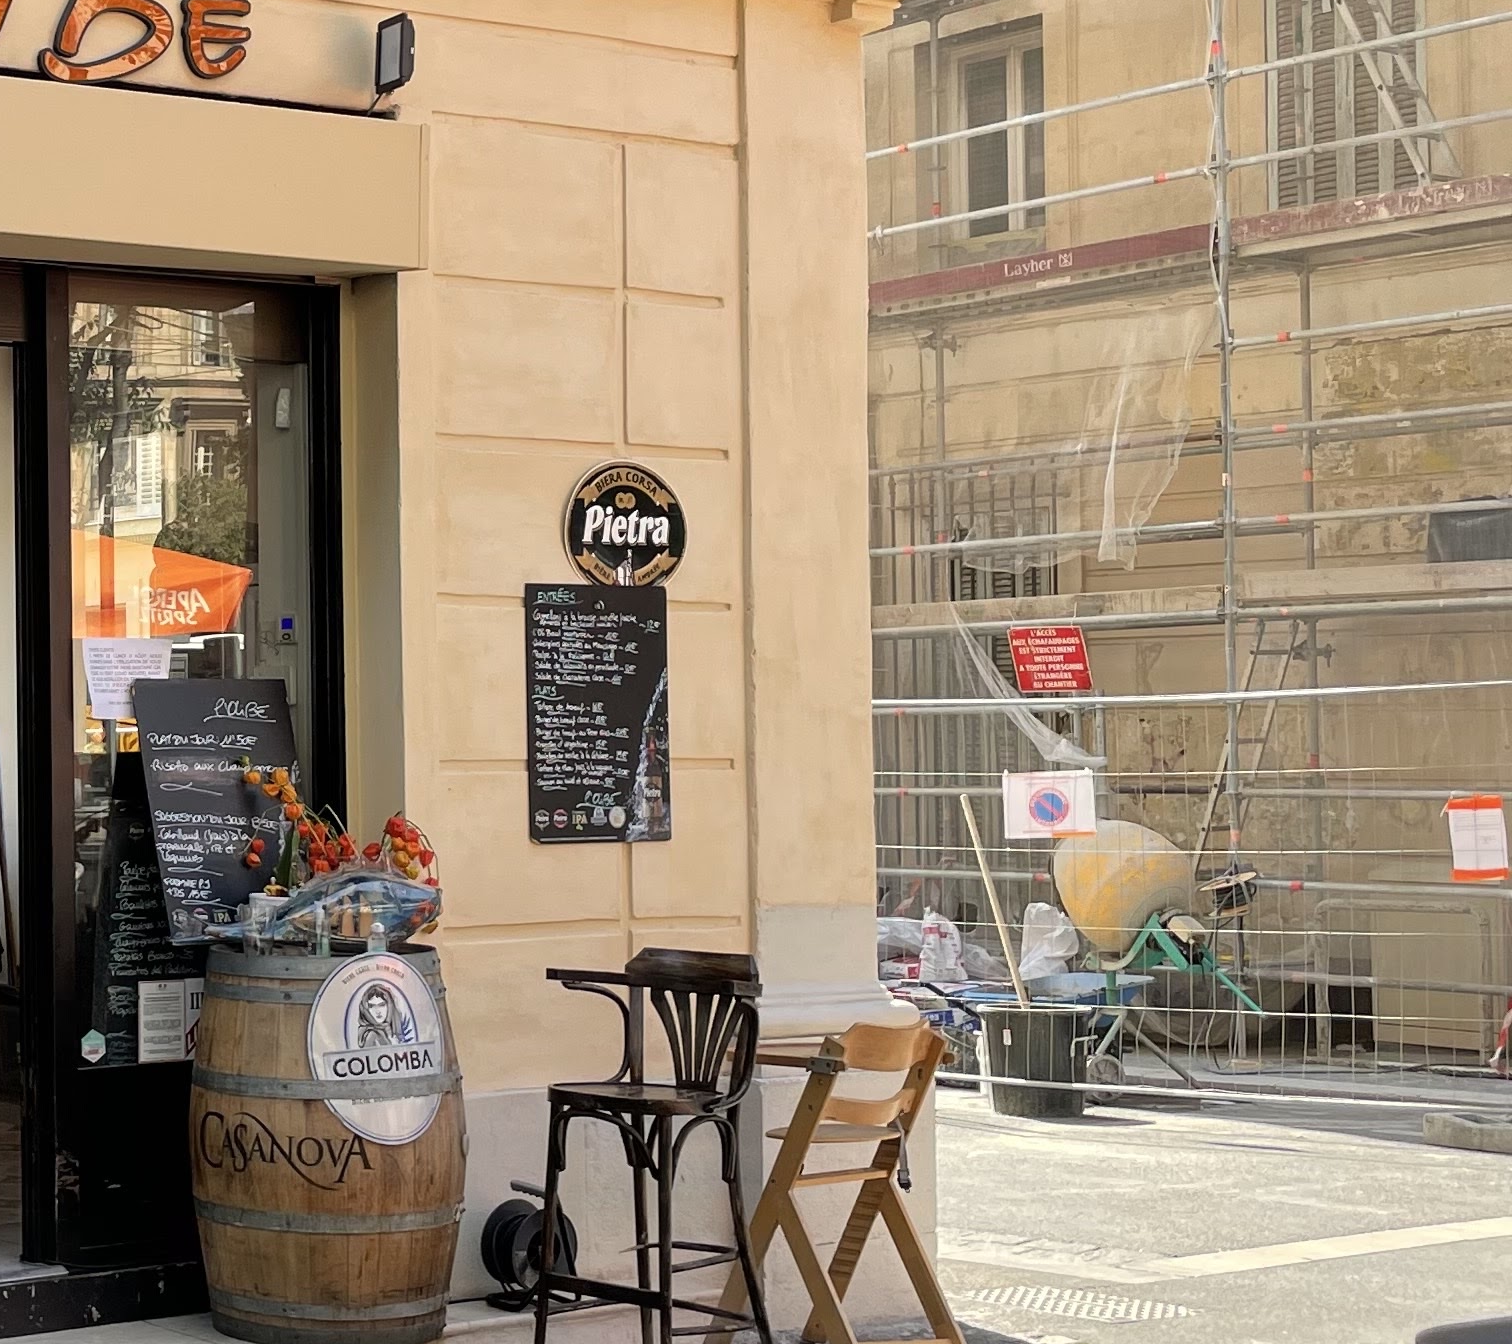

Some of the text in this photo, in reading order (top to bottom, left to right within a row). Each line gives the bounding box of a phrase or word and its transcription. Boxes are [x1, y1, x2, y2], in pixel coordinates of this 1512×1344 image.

[1004, 258, 1054, 277] Layher
[594, 471, 658, 498] BIERA CORSA
[582, 504, 670, 547] Pietra
[1032, 645, 1076, 654] STRICTEMENT
[1048, 663, 1084, 671] PERSONNE
[1044, 680, 1077, 688] CHANTIER
[572, 814, 588, 824] IPA
[333, 1049, 433, 1078] COLOMBA
[200, 1111, 375, 1191] CASANOVA
